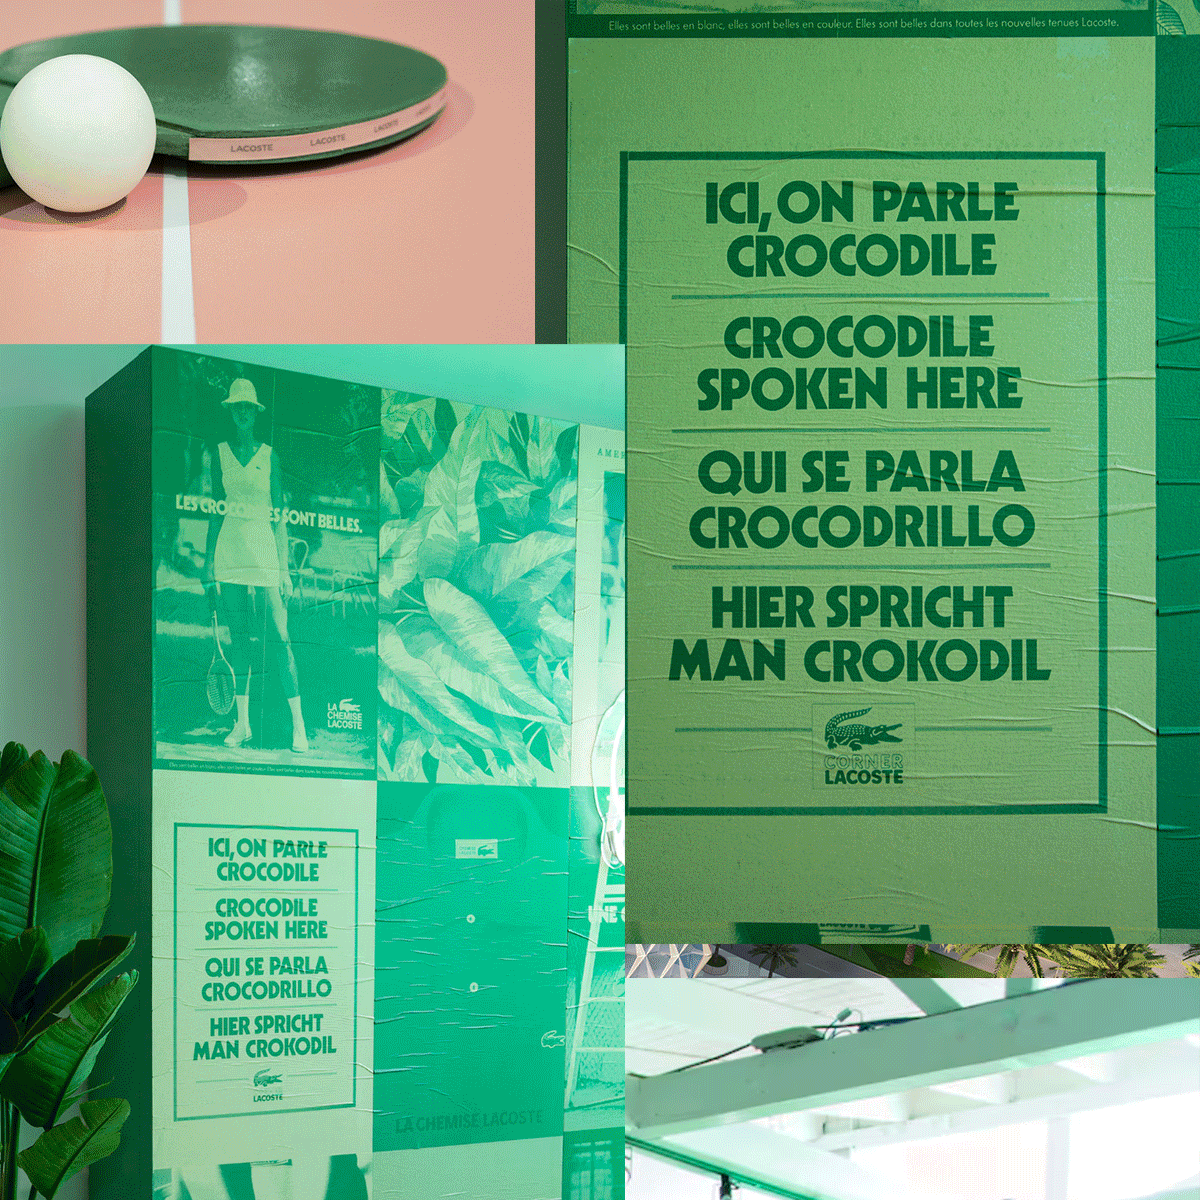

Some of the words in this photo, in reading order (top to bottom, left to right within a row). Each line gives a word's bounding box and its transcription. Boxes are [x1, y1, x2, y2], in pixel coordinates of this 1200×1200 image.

[609, 20, 629, 30] Elles
[632, 21, 651, 30] sont
[653, 20, 680, 30] belles
[683, 22, 695, 30] en
[697, 20, 725, 31] blanc,
[728, 19, 748, 30] elles
[751, 20, 770, 29] sont
[772, 19, 799, 29] belles
[802, 21, 814, 29] en
[816, 19, 853, 29] couleur.
[855, 18, 876, 28] Elles
[879, 19, 898, 28] sont
[900, 18, 927, 28] belles
[930, 17, 952, 28] dans
[955, 19, 983, 28] toutes
[986, 17, 998, 27] les
[1001, 17, 1046, 27] nouvelles
[1048, 18, 1079, 27] tenues
[1081, 17, 1119, 27] Lacoste.
[230, 143, 273, 153] LACOSTE
[310, 133, 346, 147] LACOSTE
[777, 180, 853, 223] ON
[872, 181, 1019, 222] PARLE
[726, 233, 997, 277] CROCODILE
[723, 315, 995, 359] CROCODILE
[696, 366, 887, 411] SPOKEN
[907, 366, 1023, 409] HERE
[698, 450, 786, 497] QUI
[801, 450, 851, 493] SE
[865, 450, 1026, 493] PARLA
[175, 494, 198, 512] LES
[282, 507, 316, 527] SONT
[318, 513, 363, 533] BELLES.
[689, 504, 1036, 549] CROCODRILLO
[711, 586, 816, 629] HIER
[825, 585, 1013, 629] SPRICHT
[668, 639, 786, 681] MAN
[804, 639, 1052, 683] CROKODIL
[327, 711, 362, 721] CHEMISE
[328, 702, 337, 711] LA
[327, 720, 362, 730] LACOSTE
[824, 753, 903, 769] CORNER
[824, 769, 903, 784] LACOSTE
[236, 838, 267, 858] ON
[273, 839, 328, 858] PARLE
[216, 861, 320, 882] CROCODILE
[215, 898, 318, 917] CROCODILE
[204, 920, 279, 941] SPOKEN
[285, 920, 328, 939] HERE
[205, 957, 240, 978] QUI
[245, 957, 264, 976] SE
[270, 956, 329, 975] PARLA
[201, 978, 332, 1002] CROCODRILLO
[210, 1016, 250, 1037] HIER
[254, 1013, 324, 1035] SPRICHT
[193, 1040, 239, 1061] MAN
[245, 1035, 337, 1058] CROKODIL
[253, 1093, 283, 1102] LACOSTE
[395, 1117, 414, 1134] LA
[416, 1113, 480, 1131] CHEMISE
[483, 1110, 543, 1128] LACOSTE
